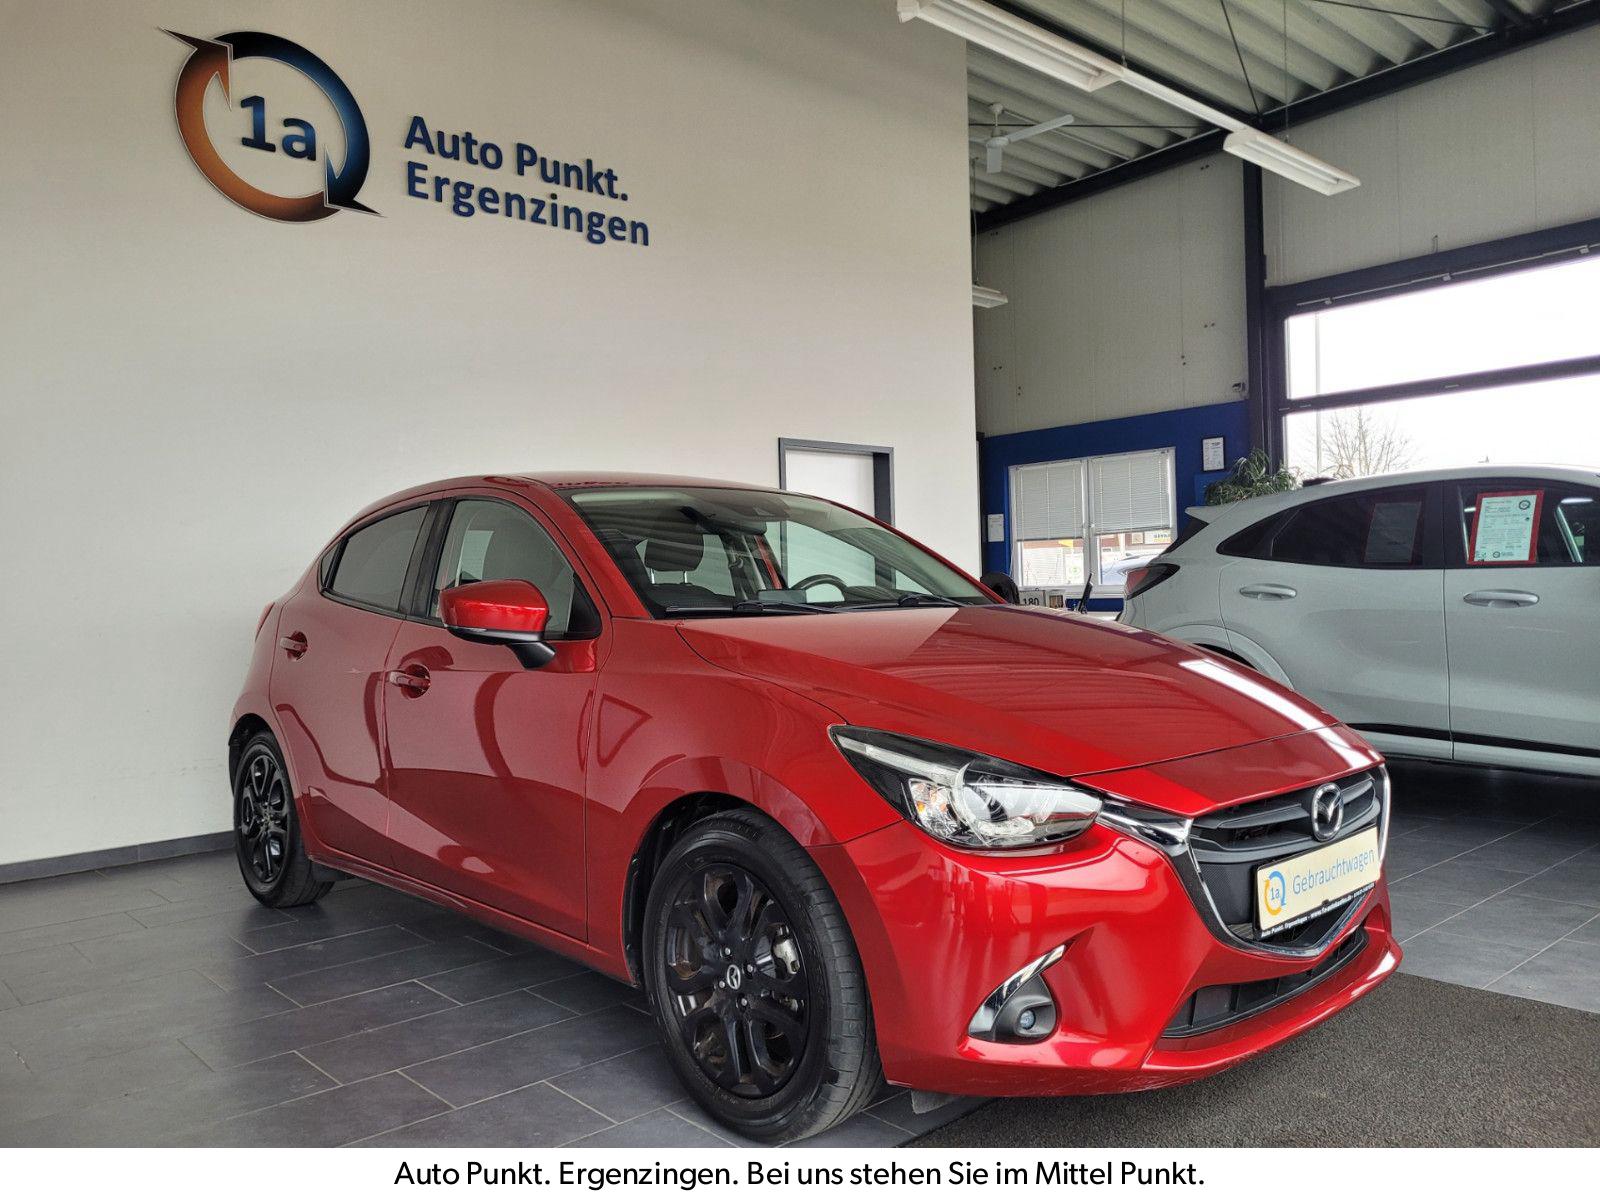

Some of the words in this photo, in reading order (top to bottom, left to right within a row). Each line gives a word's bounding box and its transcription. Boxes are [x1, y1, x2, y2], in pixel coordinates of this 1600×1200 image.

[239, 94, 317, 162] 1a
[404, 115, 504, 170] Auto
[515, 142, 630, 202] Punkt.
[406, 160, 650, 247] Ergenzingen
[1269, 886, 1281, 901] 1a
[1292, 849, 1375, 895] Gebrauchtwagen
